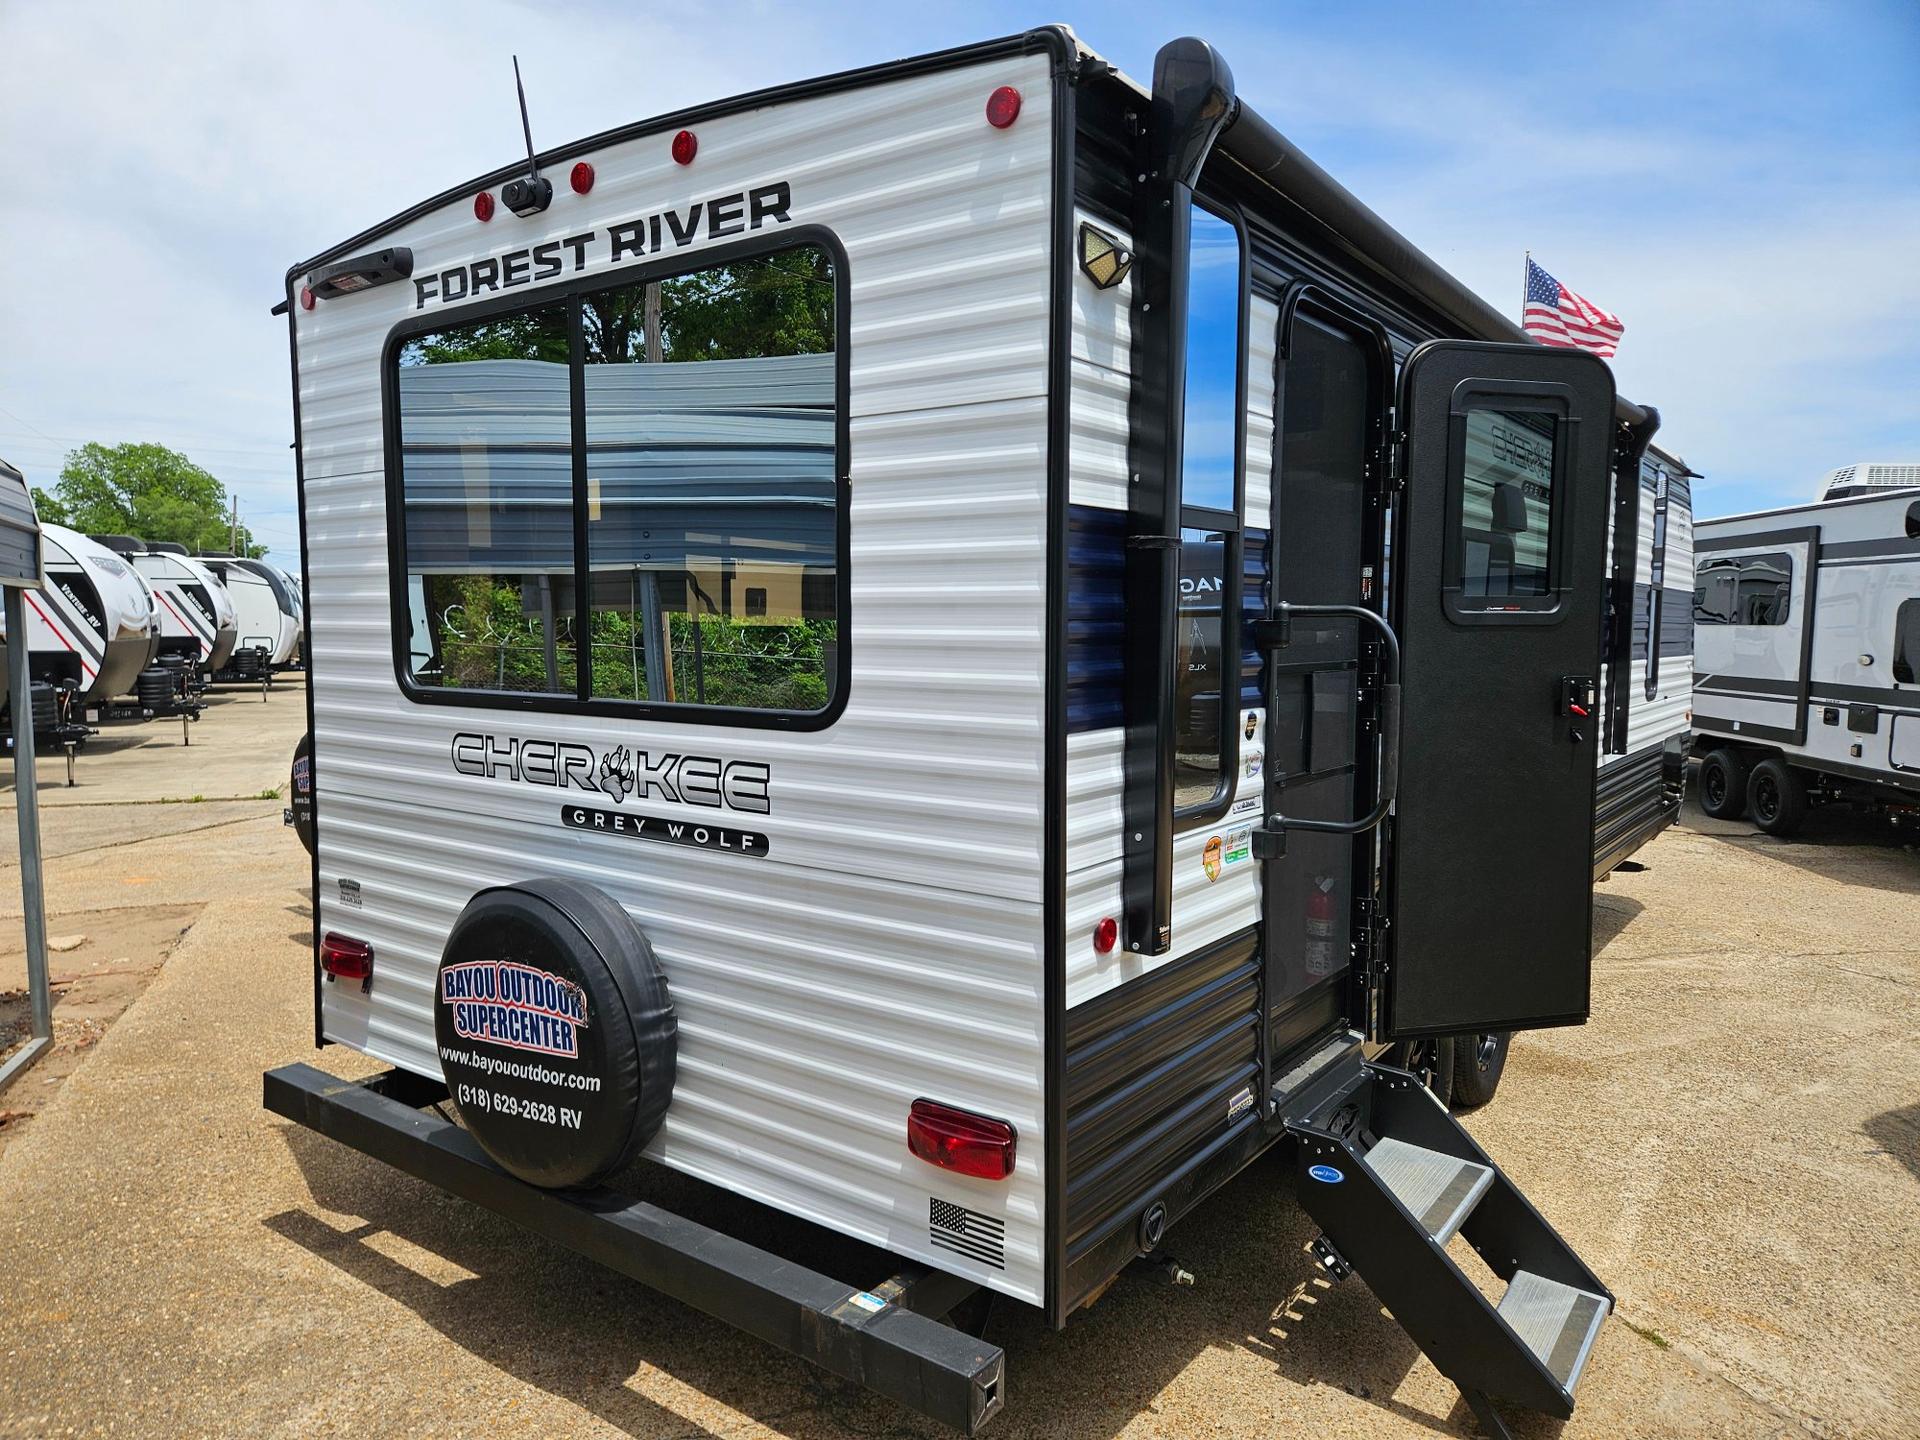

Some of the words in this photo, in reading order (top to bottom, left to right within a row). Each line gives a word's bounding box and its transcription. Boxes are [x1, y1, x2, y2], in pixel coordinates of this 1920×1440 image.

[413, 231, 595, 309] FOREST
[607, 181, 792, 262] RIVER
[573, 809, 649, 833] GREY
[667, 823, 754, 850] WOLF
[444, 966, 496, 1000] BAYOU
[499, 964, 584, 1020] OUTDOOR
[456, 1002, 574, 1051] SUPERCENTER
[440, 1045, 601, 1092] www.bayououtdoor.com
[458, 1083, 491, 1112] (318)
[494, 1092, 556, 1125] 629-2628
[560, 1107, 582, 1130] RV
